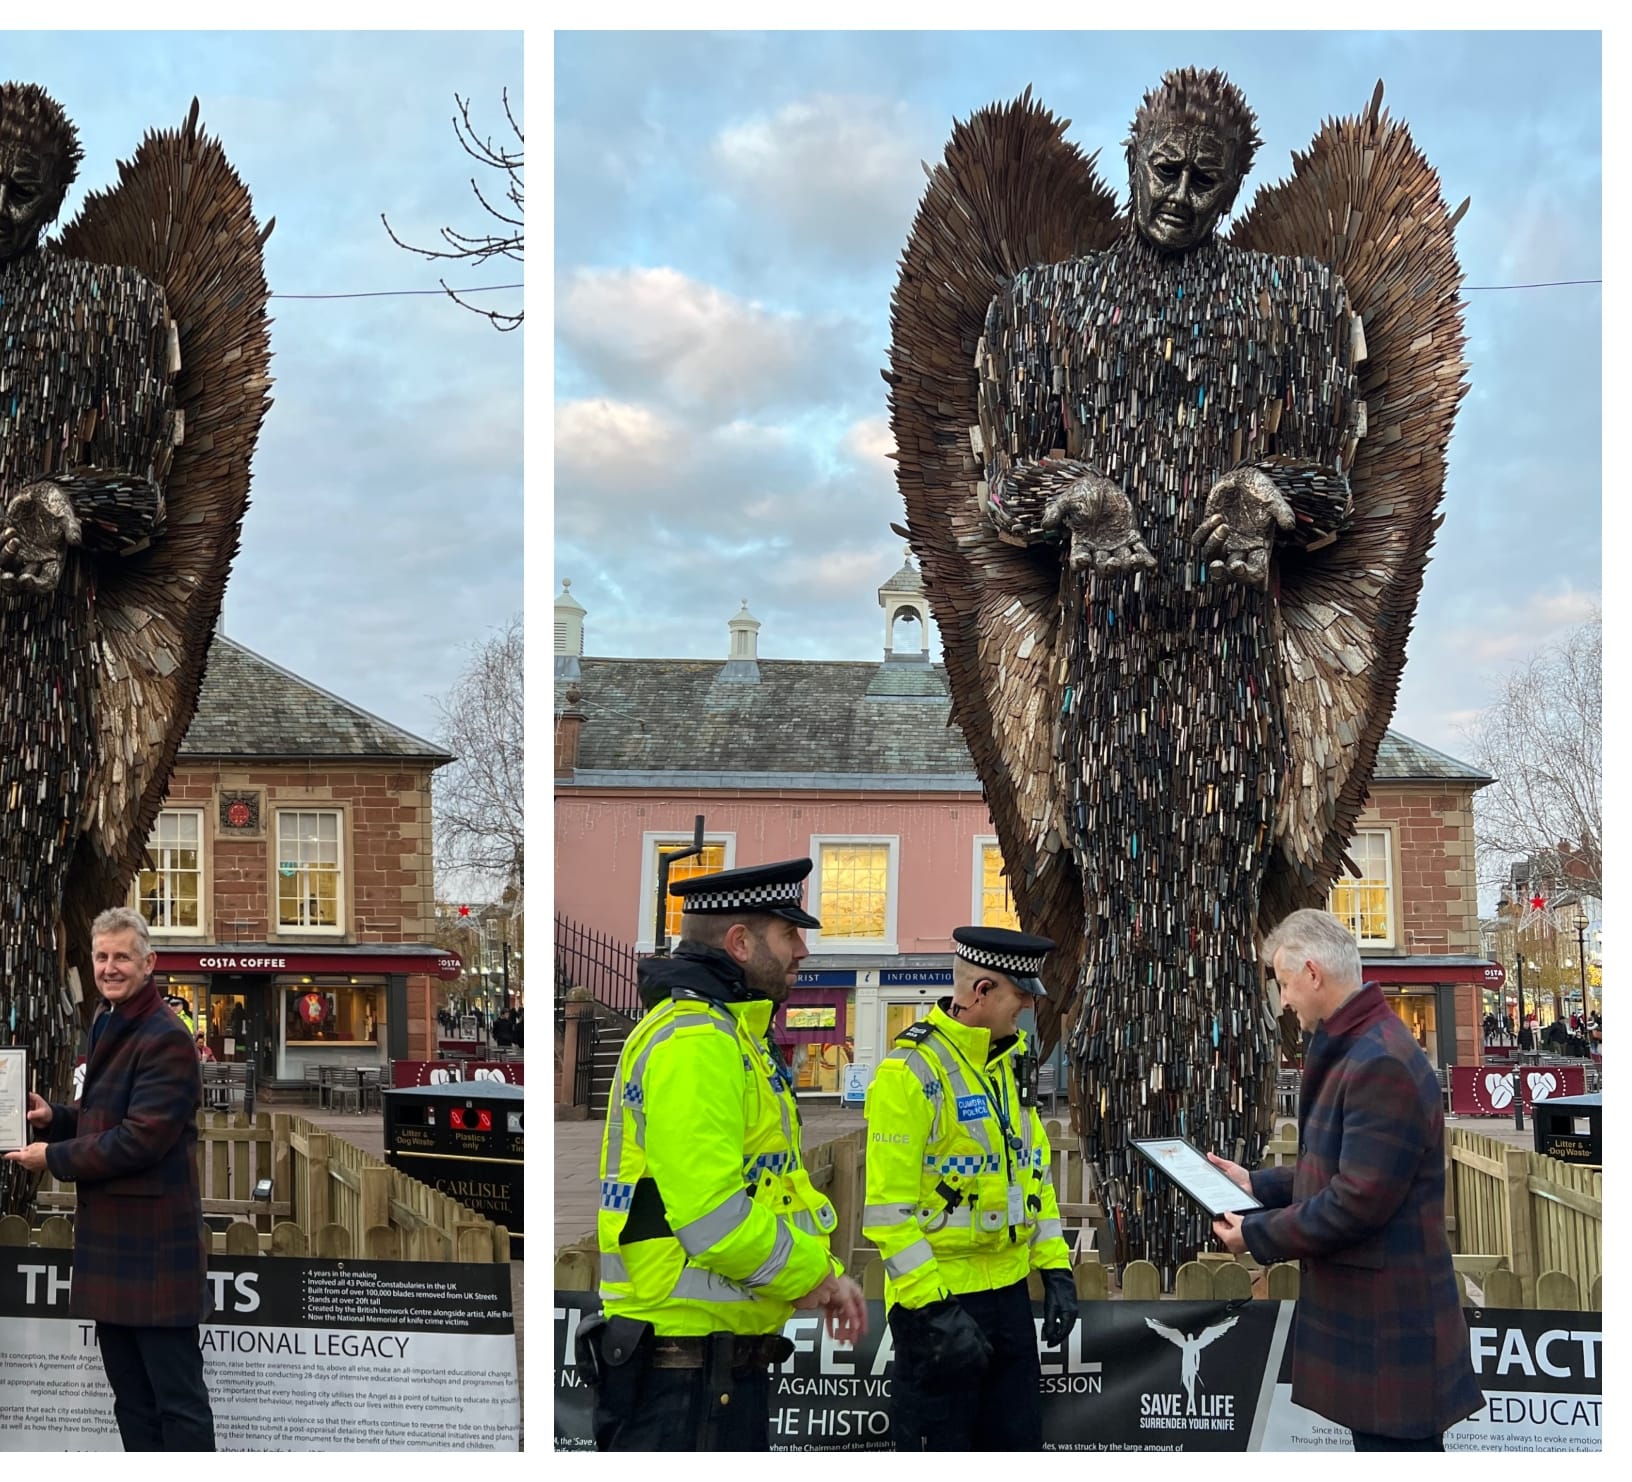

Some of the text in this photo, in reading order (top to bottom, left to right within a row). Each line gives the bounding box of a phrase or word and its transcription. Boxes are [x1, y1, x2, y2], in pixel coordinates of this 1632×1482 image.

[200, 958, 285, 967] COSTA COFFEE
[1485, 969, 1503, 977] OSTA
[397, 1137, 412, 1145] Dog
[456, 1133, 485, 1142] Plastics
[872, 1132, 909, 1144] POLICE
[463, 1143, 479, 1151] only
[1555, 1140, 1576, 1148] Litter
[1550, 1147, 1591, 1157] Dog Waste
[436, 1179, 511, 1199] CARLISLE
[465, 1199, 510, 1212] COUNCIL
[352, 1271, 376, 1279] making
[377, 1281, 425, 1290] Constabularies
[366, 1289, 391, 1297] 100,000
[308, 1296, 330, 1304] Stands
[308, 1305, 331, 1313] Created
[333, 1306, 343, 1314] by
[357, 1306, 377, 1314] British
[379, 1307, 408, 1315] Ironwork
[410, 1308, 432, 1316] Centre
[433, 1309, 466, 1317] alongside
[467, 1310, 485, 1318] artist,
[337, 1314, 365, 1322] National
[367, 1315, 397, 1323] Memorial
[407, 1316, 423, 1324] knife
[445, 1318, 468, 1326] victims
[201, 1330, 410, 1359] ATIONAL LEGACY
[778, 1378, 861, 1397] AGAINST
[1141, 1394, 1234, 1417] SAVE A LIFE
[807, 1409, 889, 1437] HISTO
[1140, 1417, 1234, 1431] SURRENDER YOUR KNIFE
